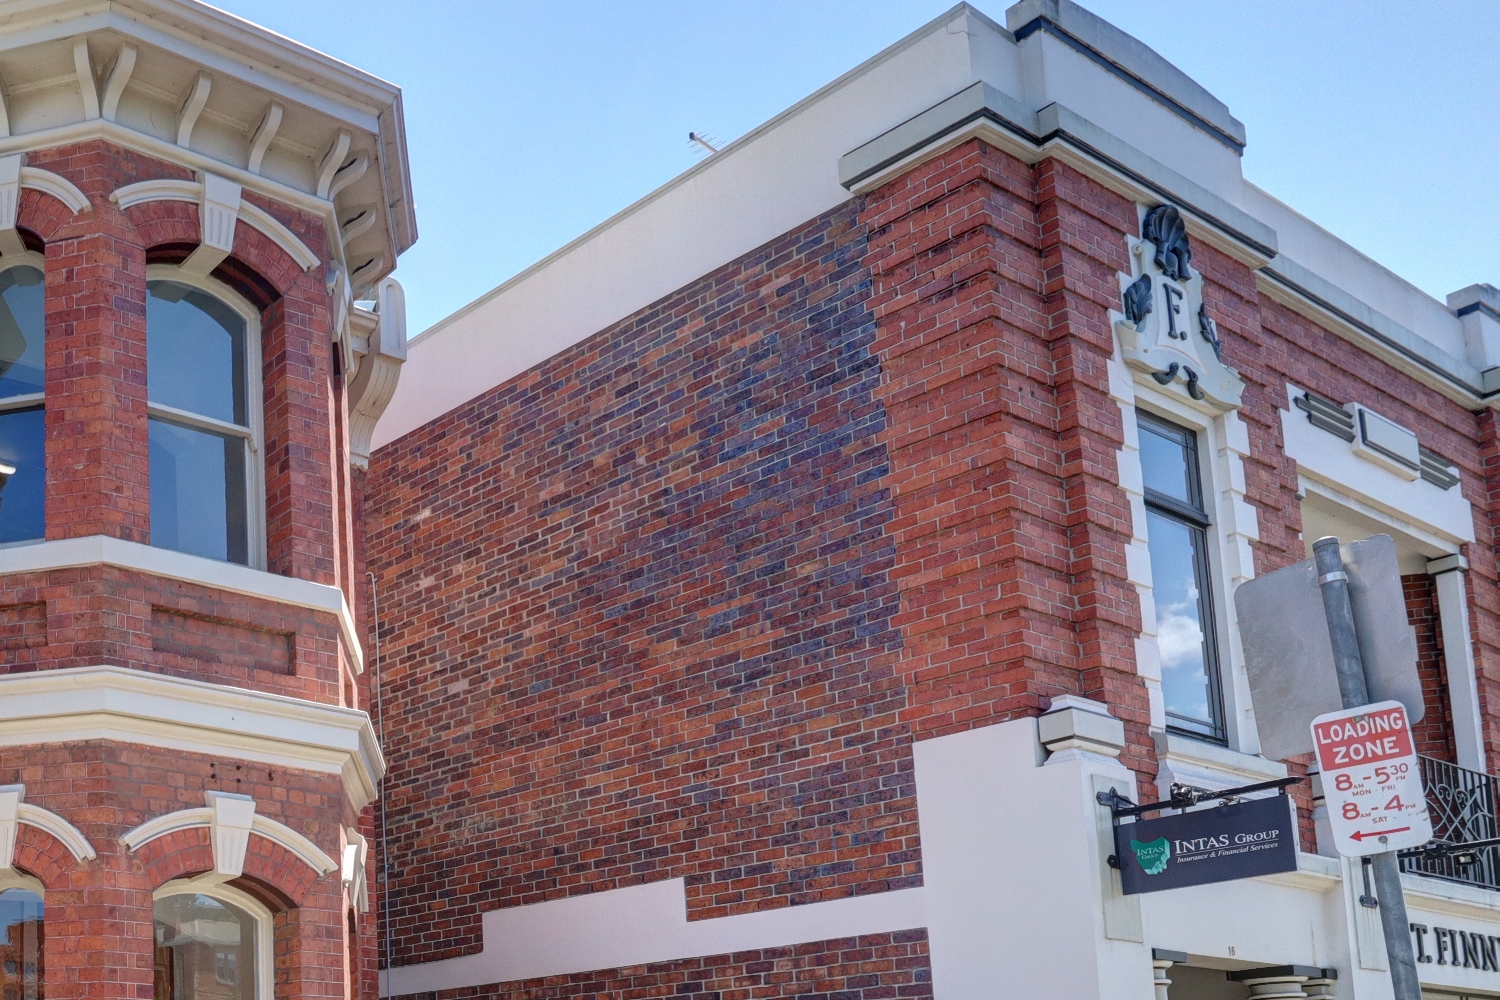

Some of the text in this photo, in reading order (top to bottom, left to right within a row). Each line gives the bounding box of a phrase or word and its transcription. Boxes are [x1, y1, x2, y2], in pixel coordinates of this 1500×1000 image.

[1318, 712, 1403, 744] LOADING
[1333, 736, 1400, 764] ZONE
[1352, 789, 1372, 797] MON
[1382, 784, 1396, 792] FRI
[1372, 816, 1388, 824] SAT
[1137, 845, 1165, 856] INTAS
[1173, 829, 1280, 855] INTAS GROUP
[1177, 853, 1209, 864] Insurance
[1217, 846, 1249, 857] Financial
[1249, 842, 1279, 852] Services
[1227, 945, 1236, 956] 16
